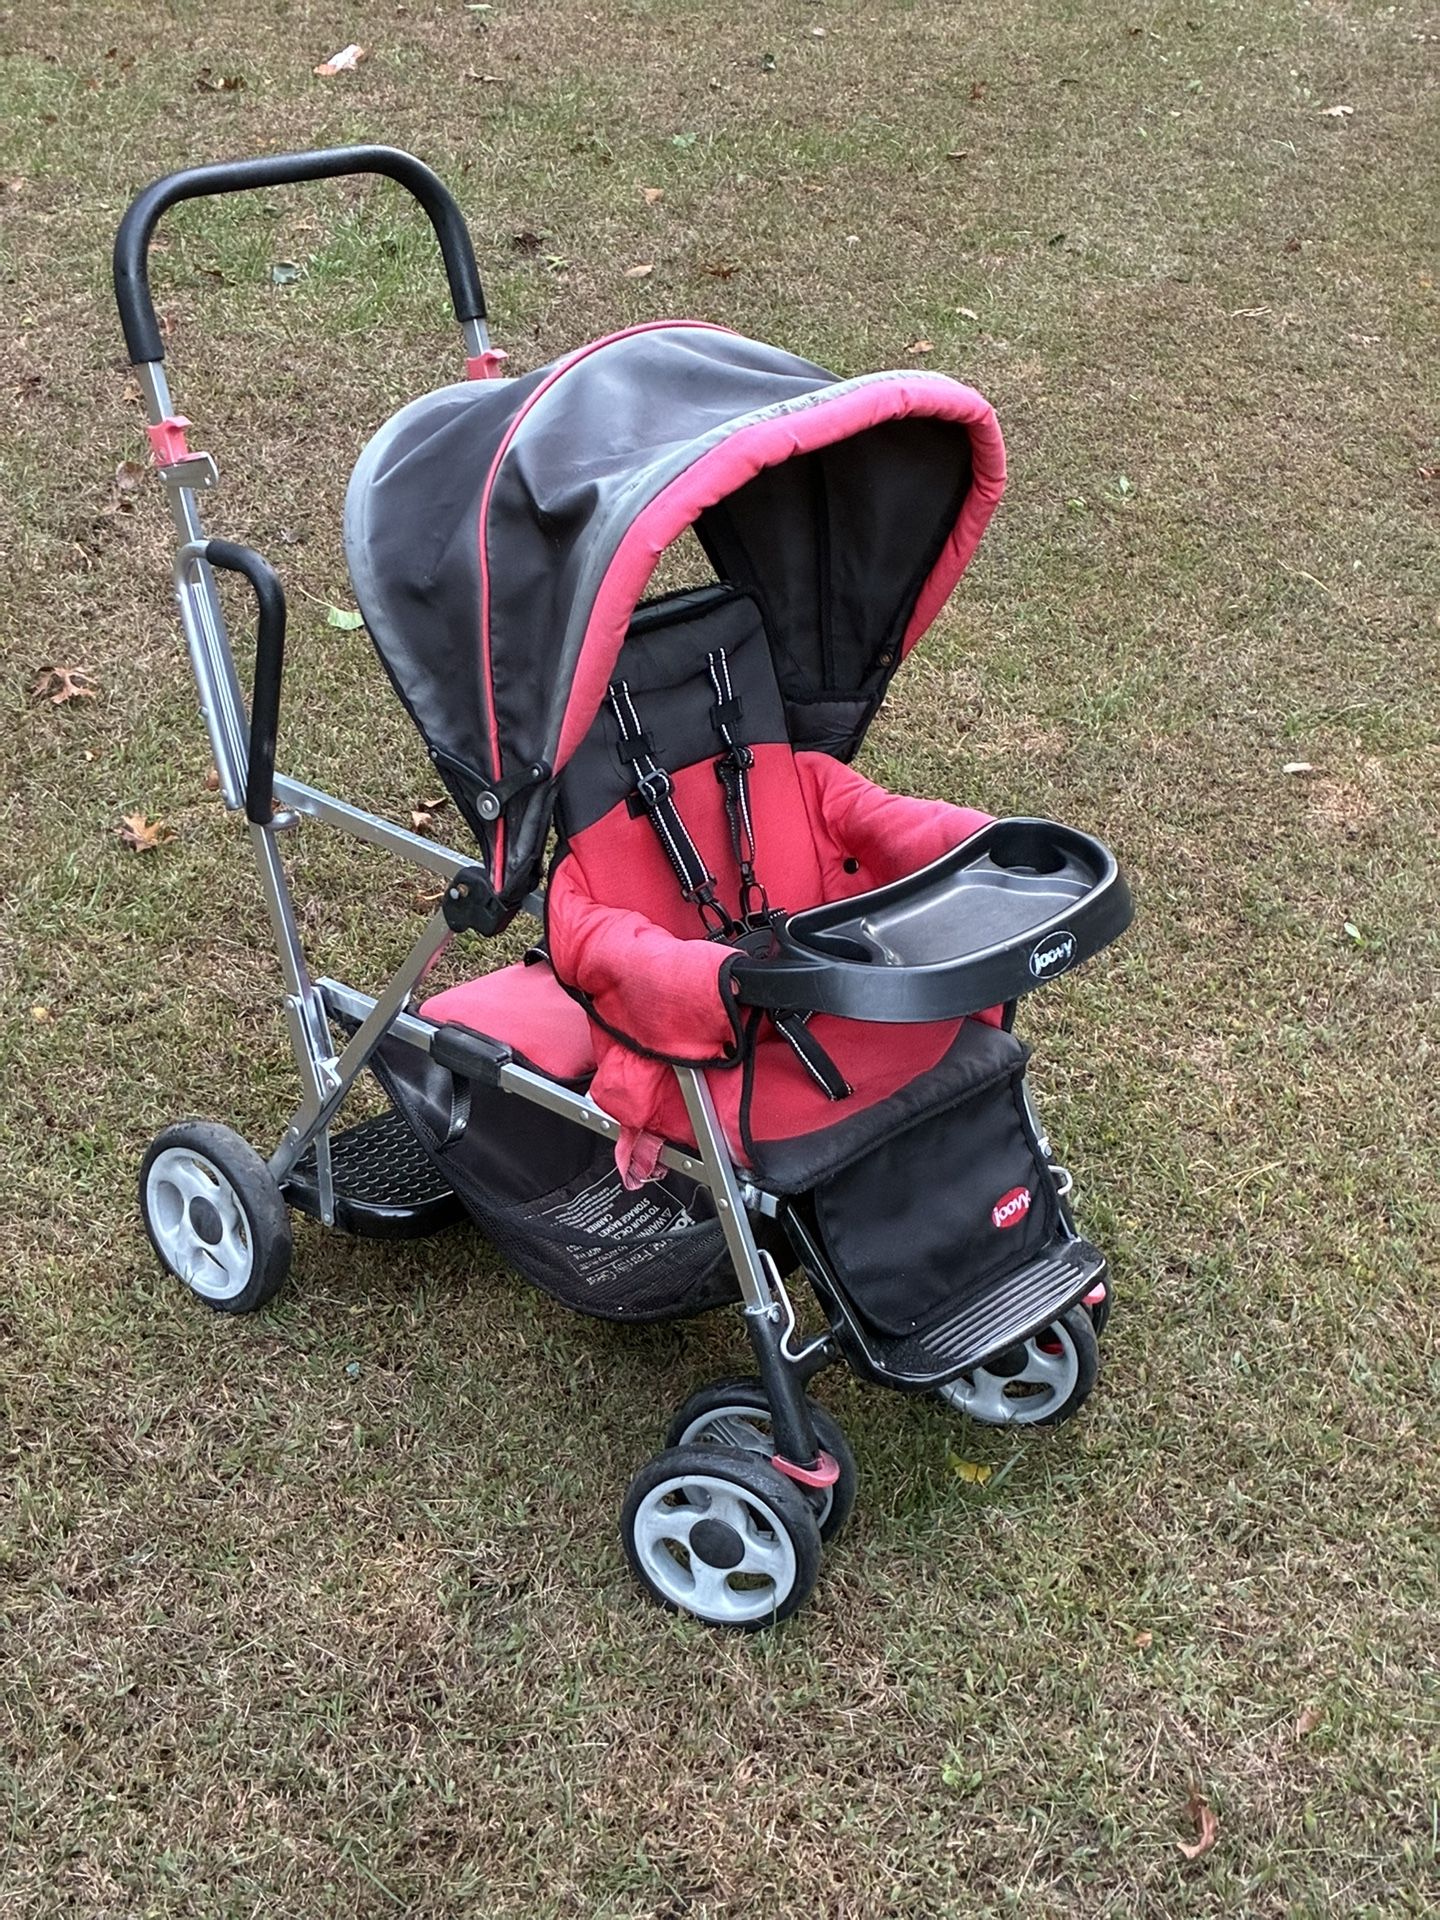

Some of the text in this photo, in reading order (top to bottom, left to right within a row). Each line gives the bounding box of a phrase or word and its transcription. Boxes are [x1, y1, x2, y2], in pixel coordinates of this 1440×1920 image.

[622, 1197, 651, 1224] STORAGE
[647, 1204, 661, 1216] TO
[992, 1189, 1032, 1228] joovy
[630, 1212, 653, 1231] YOUR
